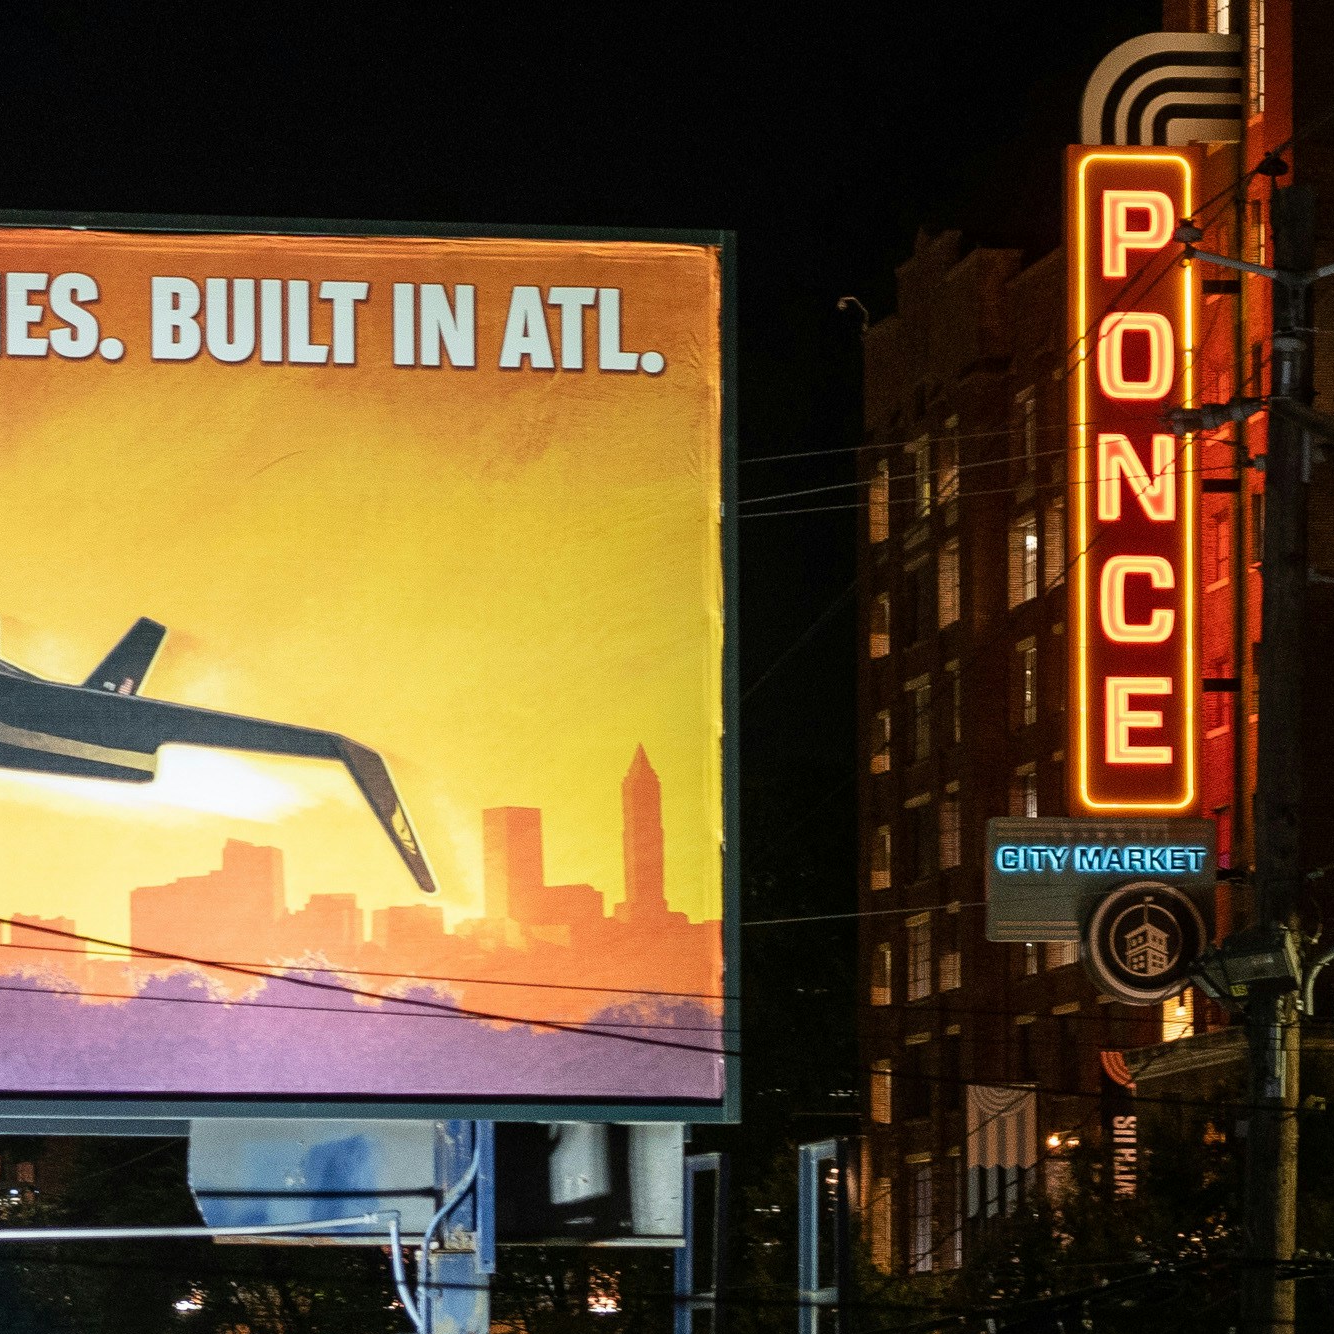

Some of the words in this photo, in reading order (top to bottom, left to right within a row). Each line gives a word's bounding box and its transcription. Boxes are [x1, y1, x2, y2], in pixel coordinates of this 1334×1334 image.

[151, 275, 369, 366] BUILT
[393, 281, 475, 368] IN
[499, 285, 666, 374] ATL.
[1096, 189, 1176, 764] PONCE
[995, 845, 1069, 873] CITY
[1074, 845, 1208, 873] MARKET
